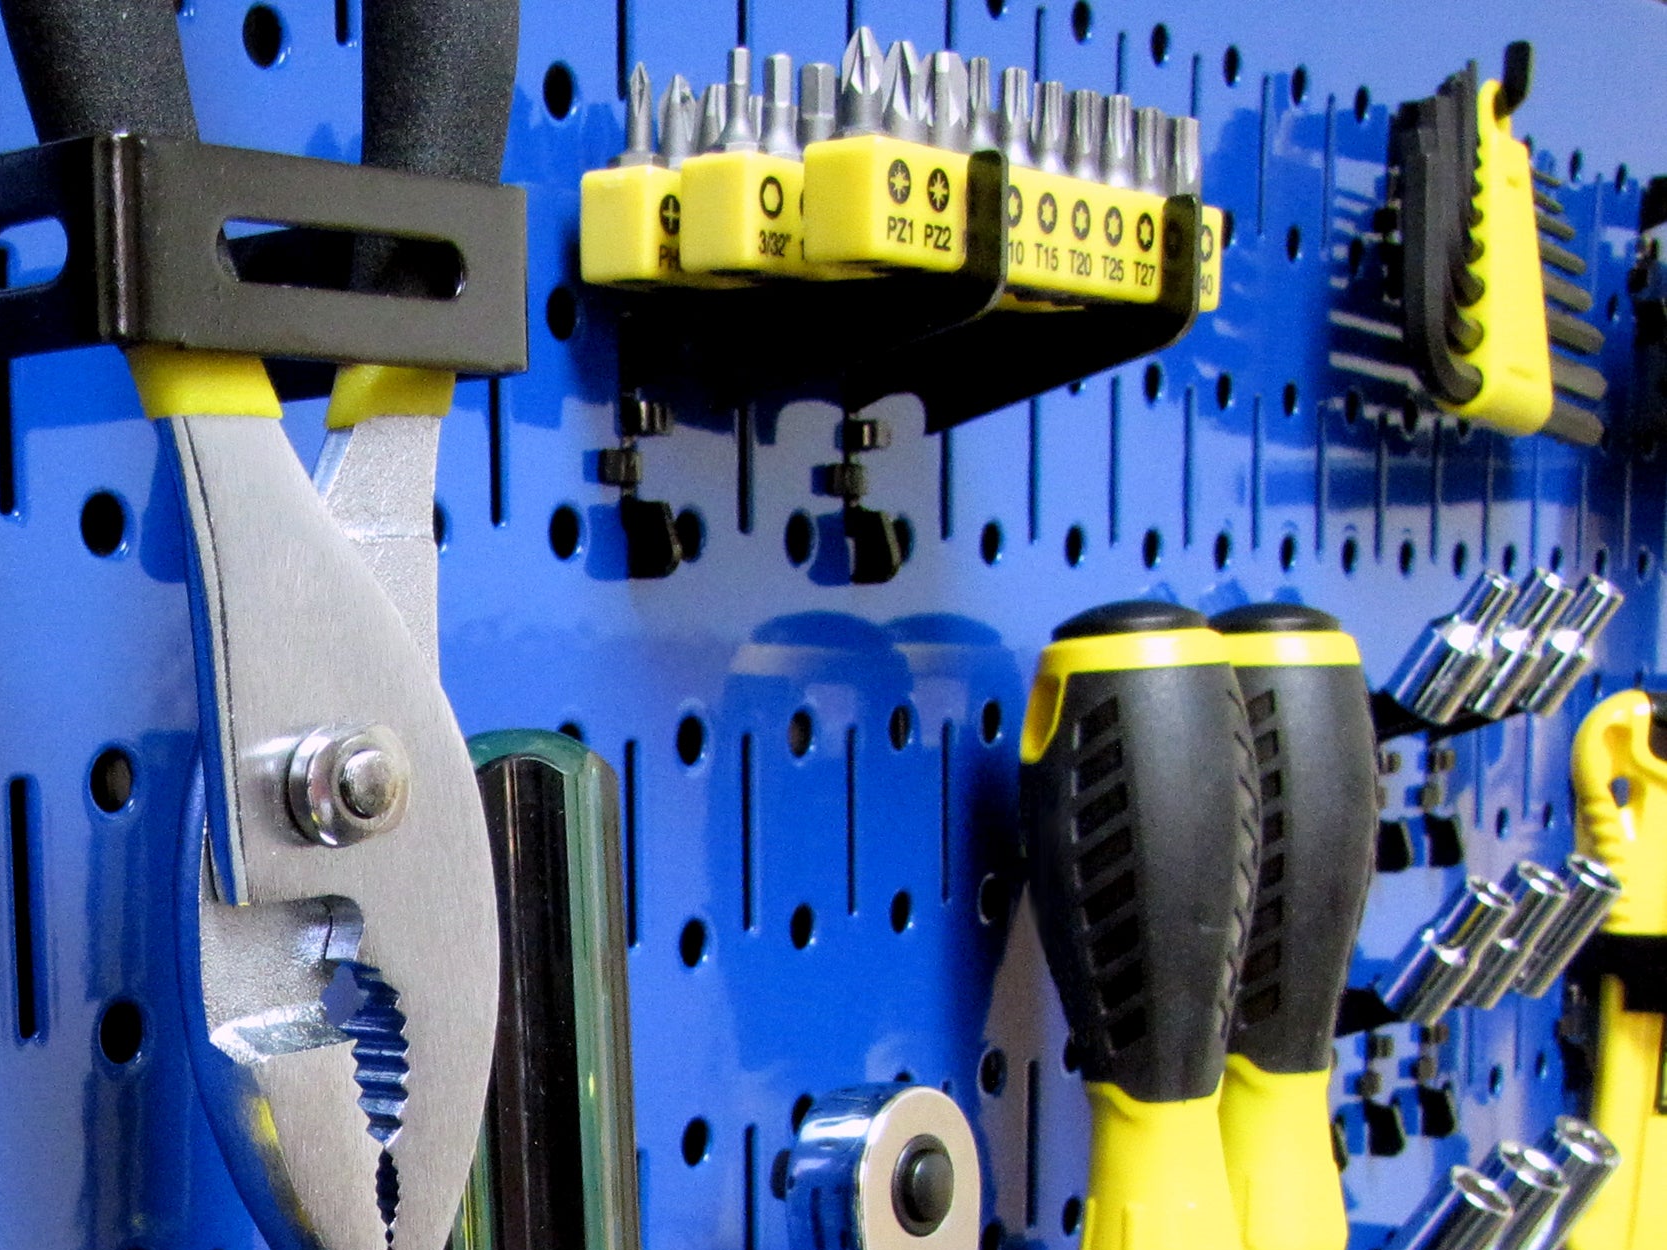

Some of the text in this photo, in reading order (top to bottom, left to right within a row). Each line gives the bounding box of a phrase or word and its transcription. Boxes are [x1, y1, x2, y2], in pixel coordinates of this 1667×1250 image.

[887, 216, 951, 251] PZ1 PZ2
[659, 244, 680, 272] PH
[1008, 240, 1156, 287] 10 T15 T20 T25 T27
[1199, 273, 1214, 296] 40
